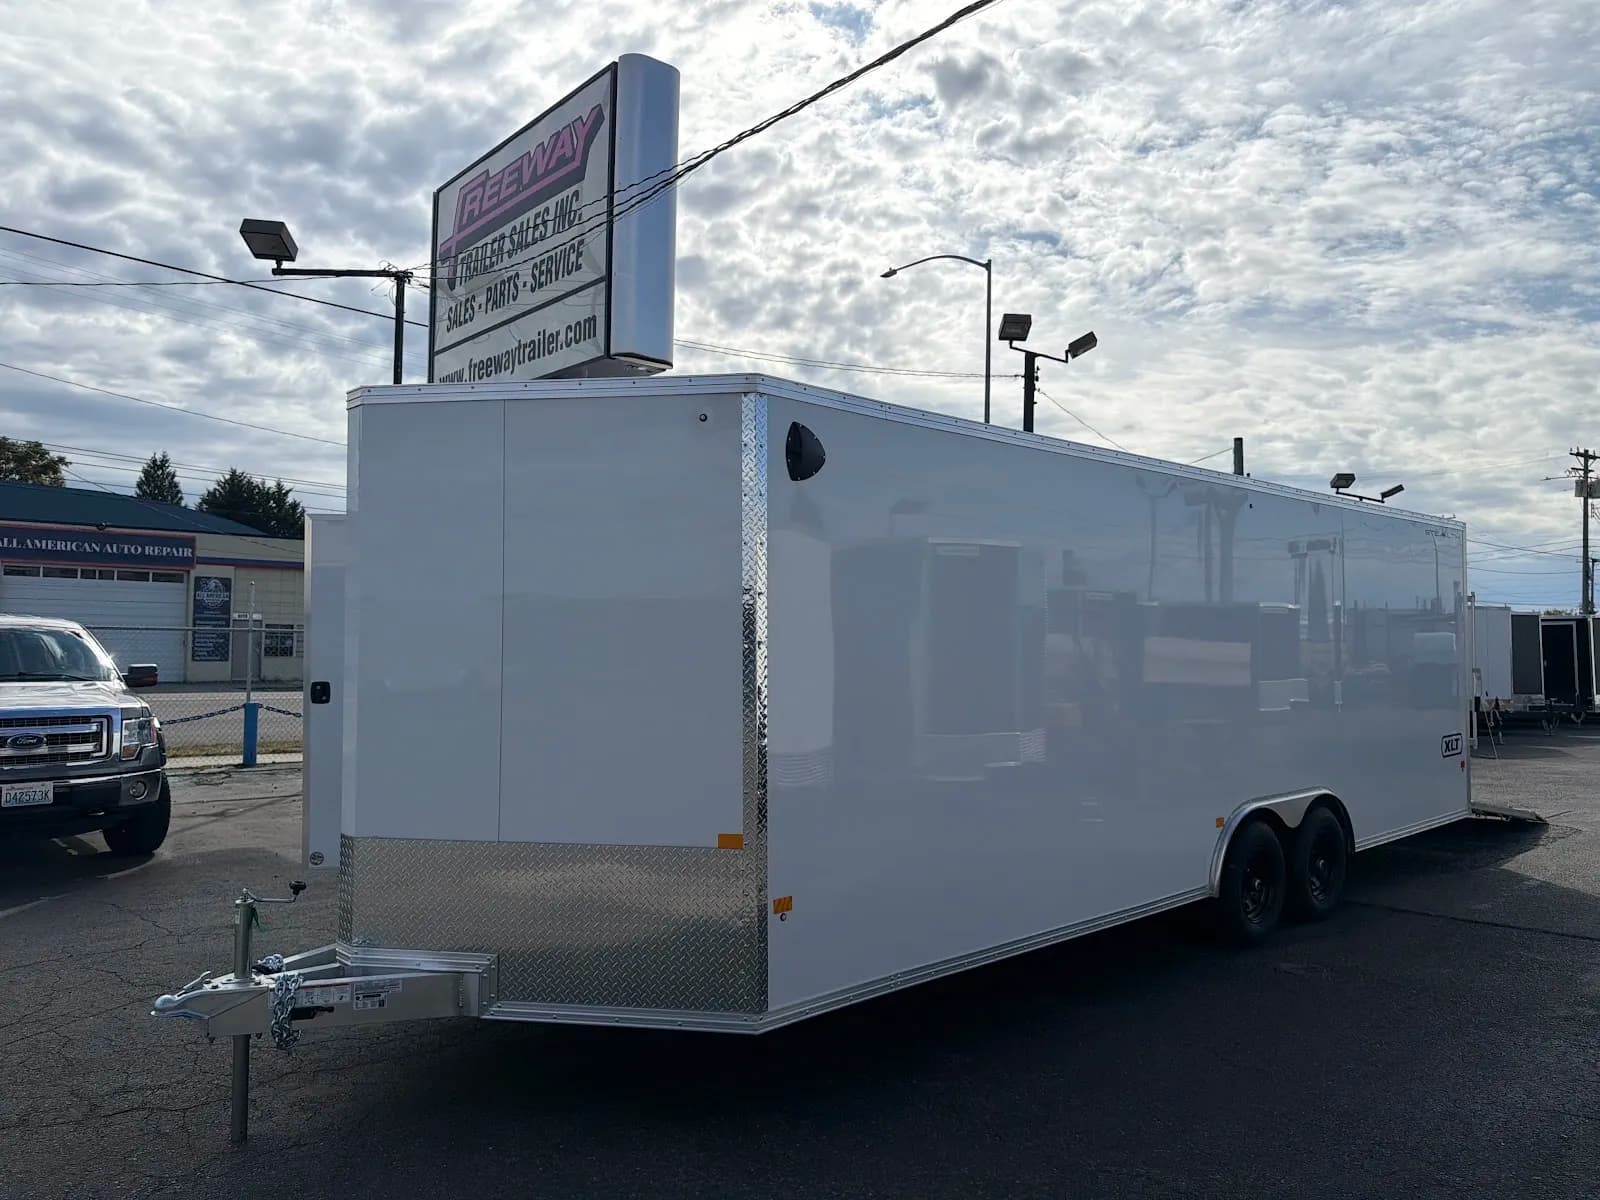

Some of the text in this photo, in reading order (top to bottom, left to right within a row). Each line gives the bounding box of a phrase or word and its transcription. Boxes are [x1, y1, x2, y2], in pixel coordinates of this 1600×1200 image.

[459, 189, 583, 286] TRAILER SALES INC.
[446, 294, 476, 333] SALES
[485, 272, 520, 315] PARTS
[530, 239, 584, 293] SERVICE
[22, 539, 101, 553] AMERICAN
[103, 543, 142, 555] AUTO
[144, 546, 193, 557] REPAIR
[16, 736, 37, 744] Ford
[1444, 738, 1460, 753] XLT
